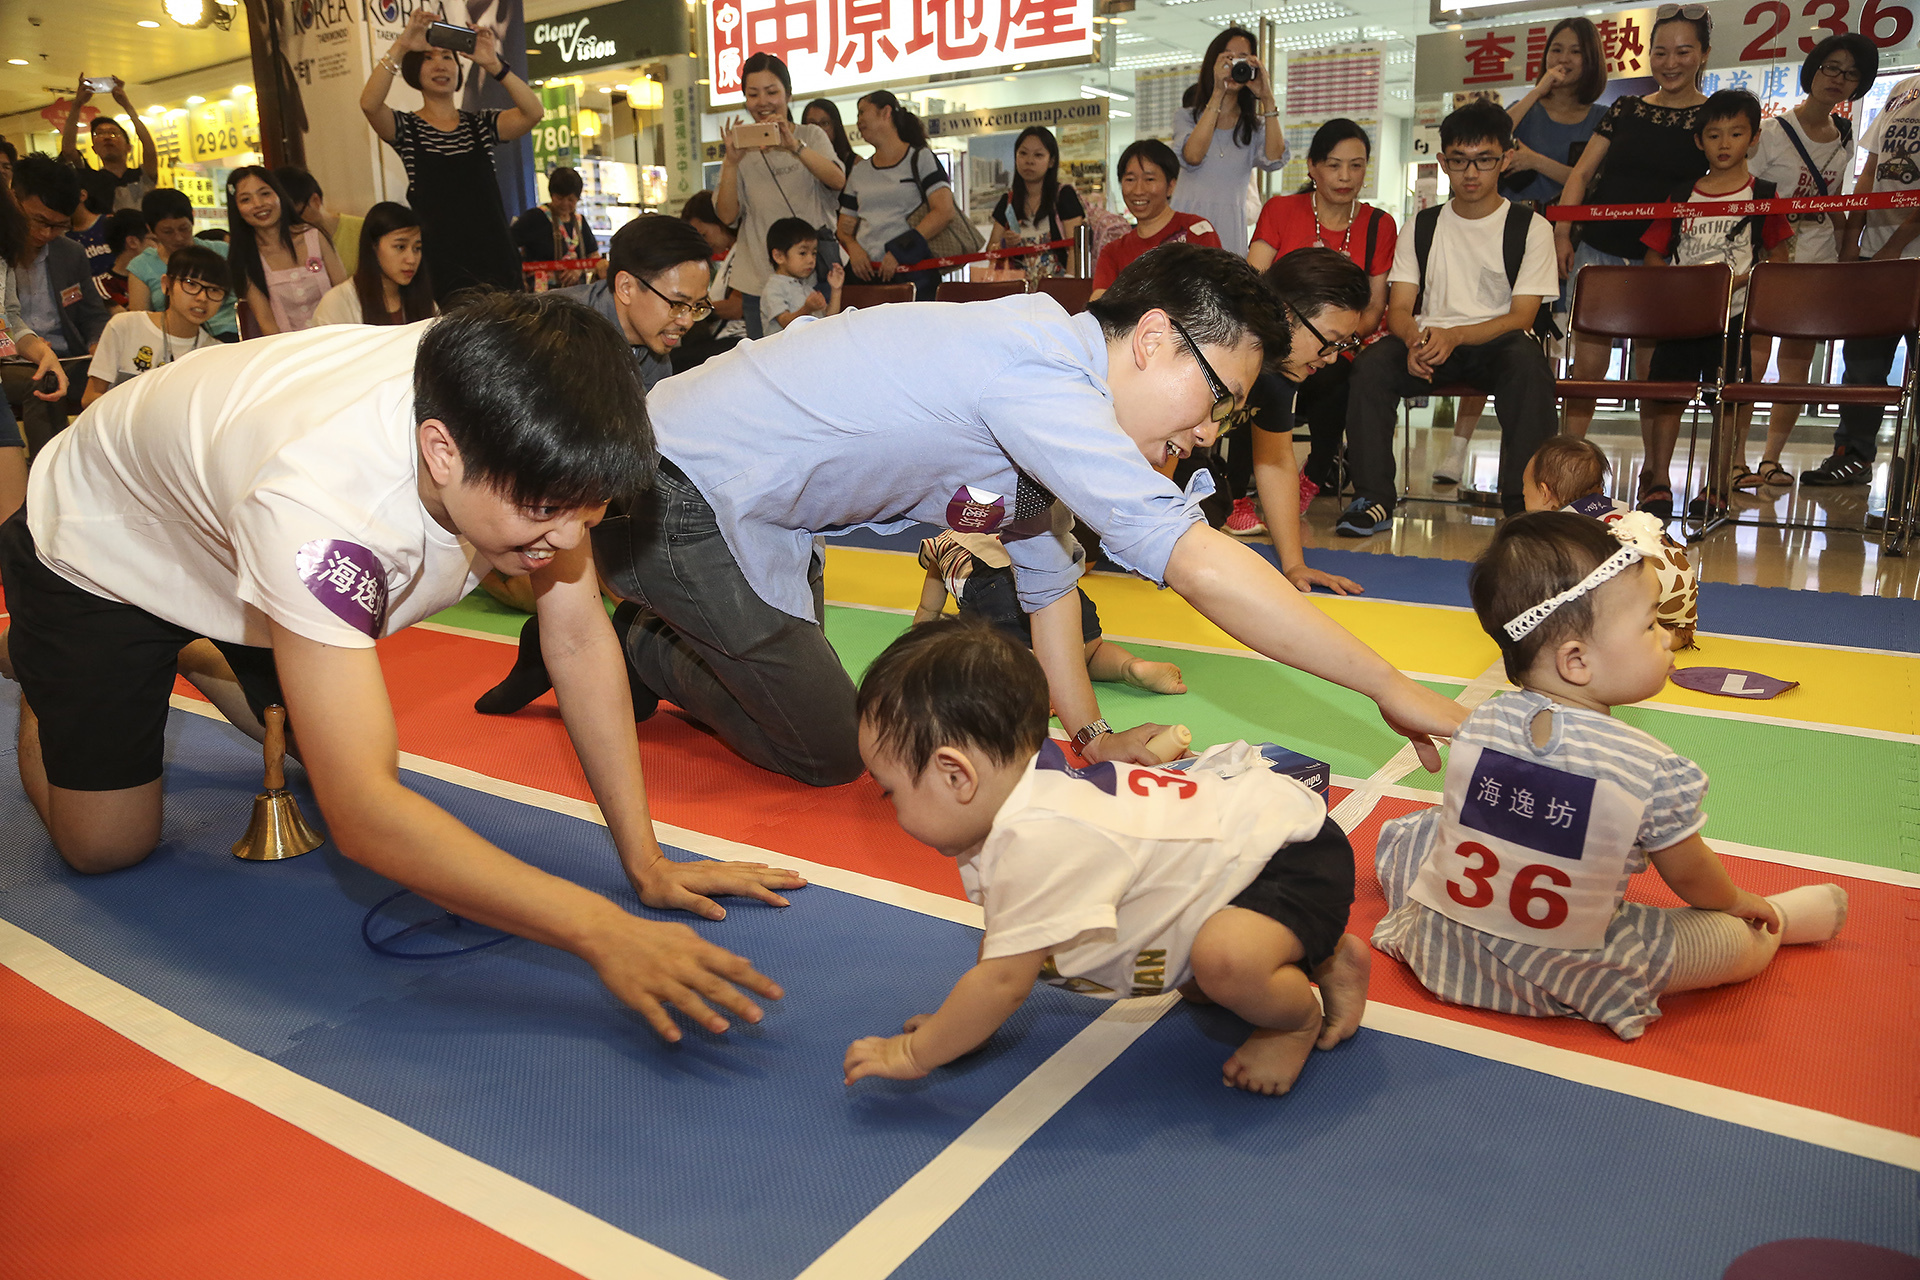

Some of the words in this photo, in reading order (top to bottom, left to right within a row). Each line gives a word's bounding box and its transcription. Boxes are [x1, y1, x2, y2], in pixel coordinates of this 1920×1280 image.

[291, 0, 354, 35] KOREA
[1739, 0, 1914, 61] 236
[534, 22, 578, 44] Clear
[557, 17, 617, 63] Vision
[714, 3, 742, 88] 中原
[746, 0, 1086, 76] 中原地產
[949, 103, 1102, 131] www.centamap.com
[1885, 124, 1920, 140] BAB
[195, 126, 239, 155] 2926
[531, 124, 570, 153] 780
[1589, 207, 1603, 217] The
[1604, 207, 1634, 219] Laguna
[1635, 206, 1655, 216] Mall
[1791, 200, 1807, 209] The
[1809, 199, 1844, 211] Laguna
[1845, 197, 1869, 206] Mall
[1476, 775, 1577, 830] 海逸坊
[1445, 840, 1572, 930] 36
